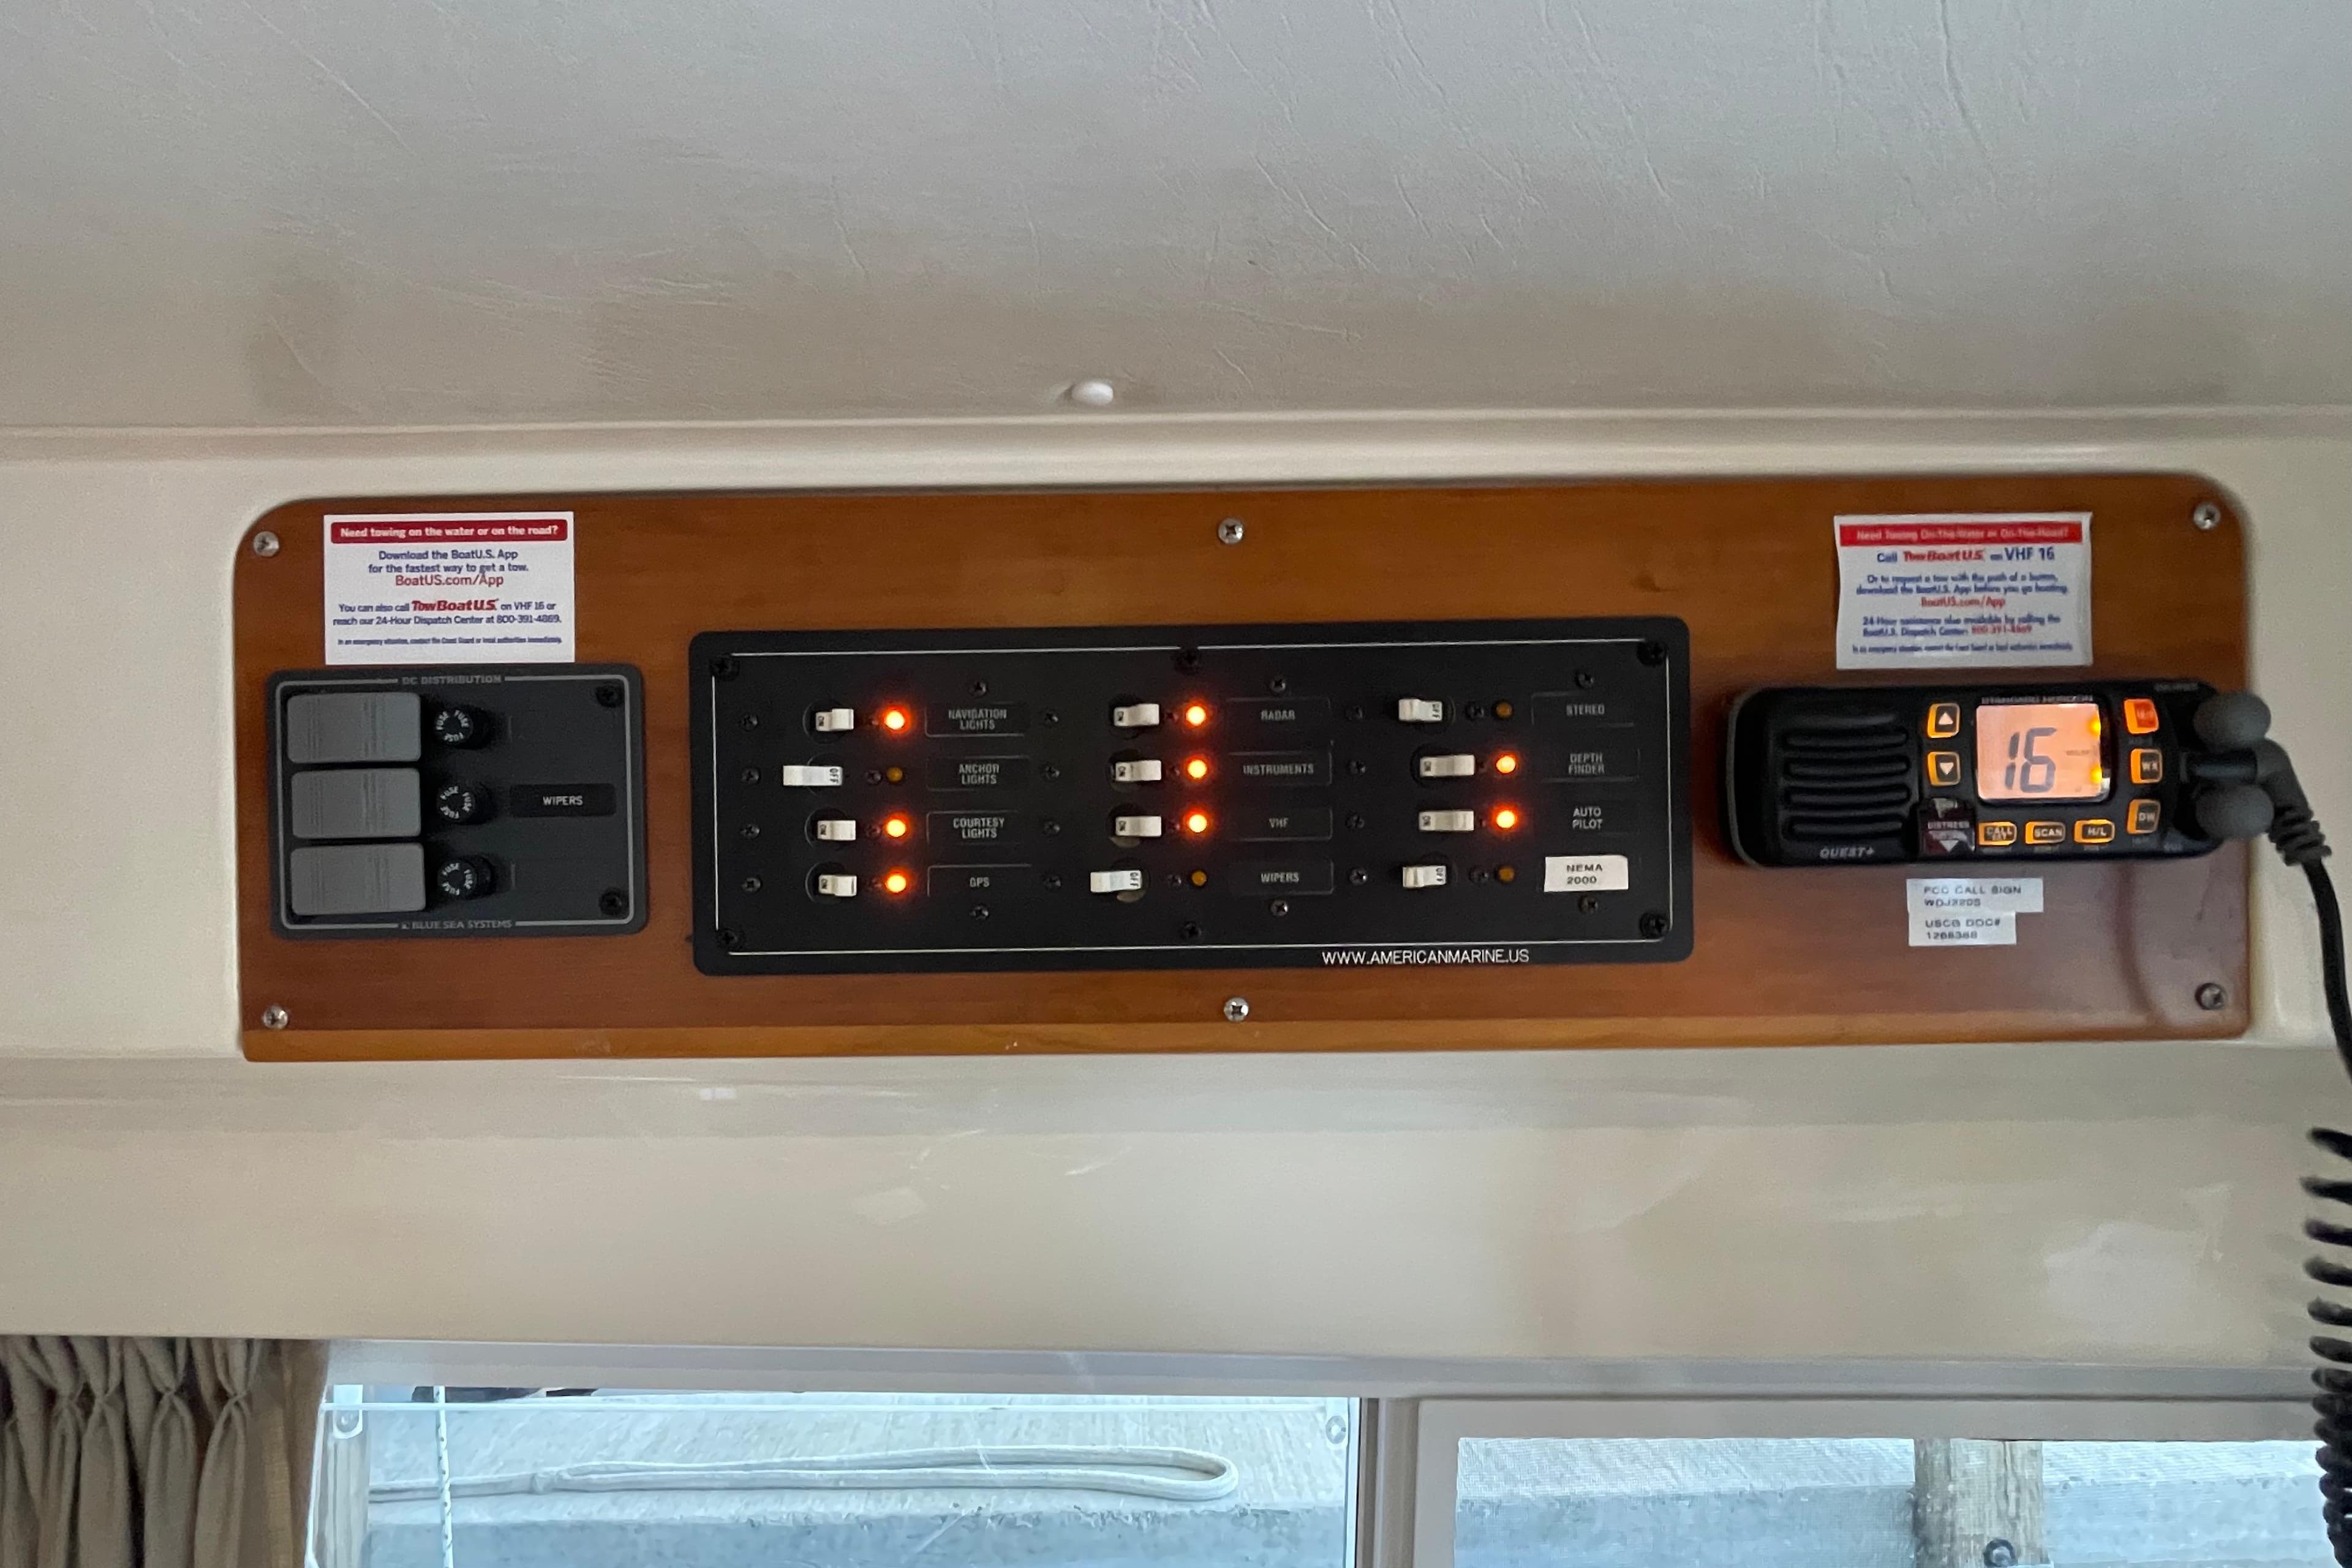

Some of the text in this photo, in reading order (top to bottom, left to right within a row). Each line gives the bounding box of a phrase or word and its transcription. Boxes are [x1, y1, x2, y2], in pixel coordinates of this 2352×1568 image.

[341, 527, 368, 537] Need
[371, 527, 406, 539] towing
[425, 527, 443, 537] the
[445, 527, 475, 536] water
[508, 526, 526, 535] the
[528, 525, 559, 535] road?
[379, 550, 429, 560] Download
[432, 550, 448, 560] the
[497, 549, 519, 560] App
[1877, 552, 1898, 563] Call
[2004, 547, 2034, 561] VHF
[2038, 546, 2055, 561] 16
[368, 564, 383, 573] for
[386, 564, 403, 573] the
[405, 564, 440, 573] fastest
[443, 565, 464, 575] way
[466, 563, 477, 572] to
[479, 563, 497, 575] get
[508, 562, 529, 572] tow.
[396, 573, 505, 588] BoatUS.com/App
[1954, 584, 1972, 595] App
[2003, 586, 2020, 595] you
[339, 603, 356, 612] You
[375, 603, 393, 612] also
[395, 603, 410, 612] call
[513, 601, 533, 611] VHF
[535, 601, 545, 611] 16
[333, 617, 358, 626] reach
[375, 616, 412, 625] 24-Hour
[414, 616, 453, 626] Dispatch
[454, 615, 484, 624] Center
[486, 616, 494, 624] at
[402, 674, 502, 685] DC DISTRIBUTION
[948, 708, 1008, 720] NAVIGATION
[1261, 709, 1296, 721] RADAR
[1566, 704, 1605, 716] STEREO
[959, 719, 995, 731] LIGHTS
[1570, 752, 1603, 764] DEPTH
[2004, 726, 2058, 794] 16
[959, 763, 1000, 774] ANCHOR
[1243, 763, 1314, 775] INSTRUMENTS
[1568, 764, 1605, 775] FINDER
[961, 774, 997, 785] LIGHTS
[543, 795, 584, 806] WIPERS
[1572, 805, 1602, 818] AUTO
[953, 816, 1005, 829] COURTESY
[1268, 816, 1289, 829] VHF
[1572, 818, 1604, 830] PILOT
[962, 827, 998, 839] LIGHTS
[1986, 826, 2013, 837] CALL
[2034, 827, 2064, 838] SCAN
[2087, 826, 2108, 836] H/L
[1566, 864, 1604, 873] NEMA
[970, 876, 990, 888] GPS
[1261, 872, 1300, 883] WIPERS
[1567, 875, 1597, 885] 2000
[1955, 886, 1986, 894] CALL
[1992, 885, 2021, 894] SIGN
[412, 920, 513, 929] BLUE SEA SYSTEMS
[1322, 949, 1530, 965] WWW.AMERICANMARINE.US
